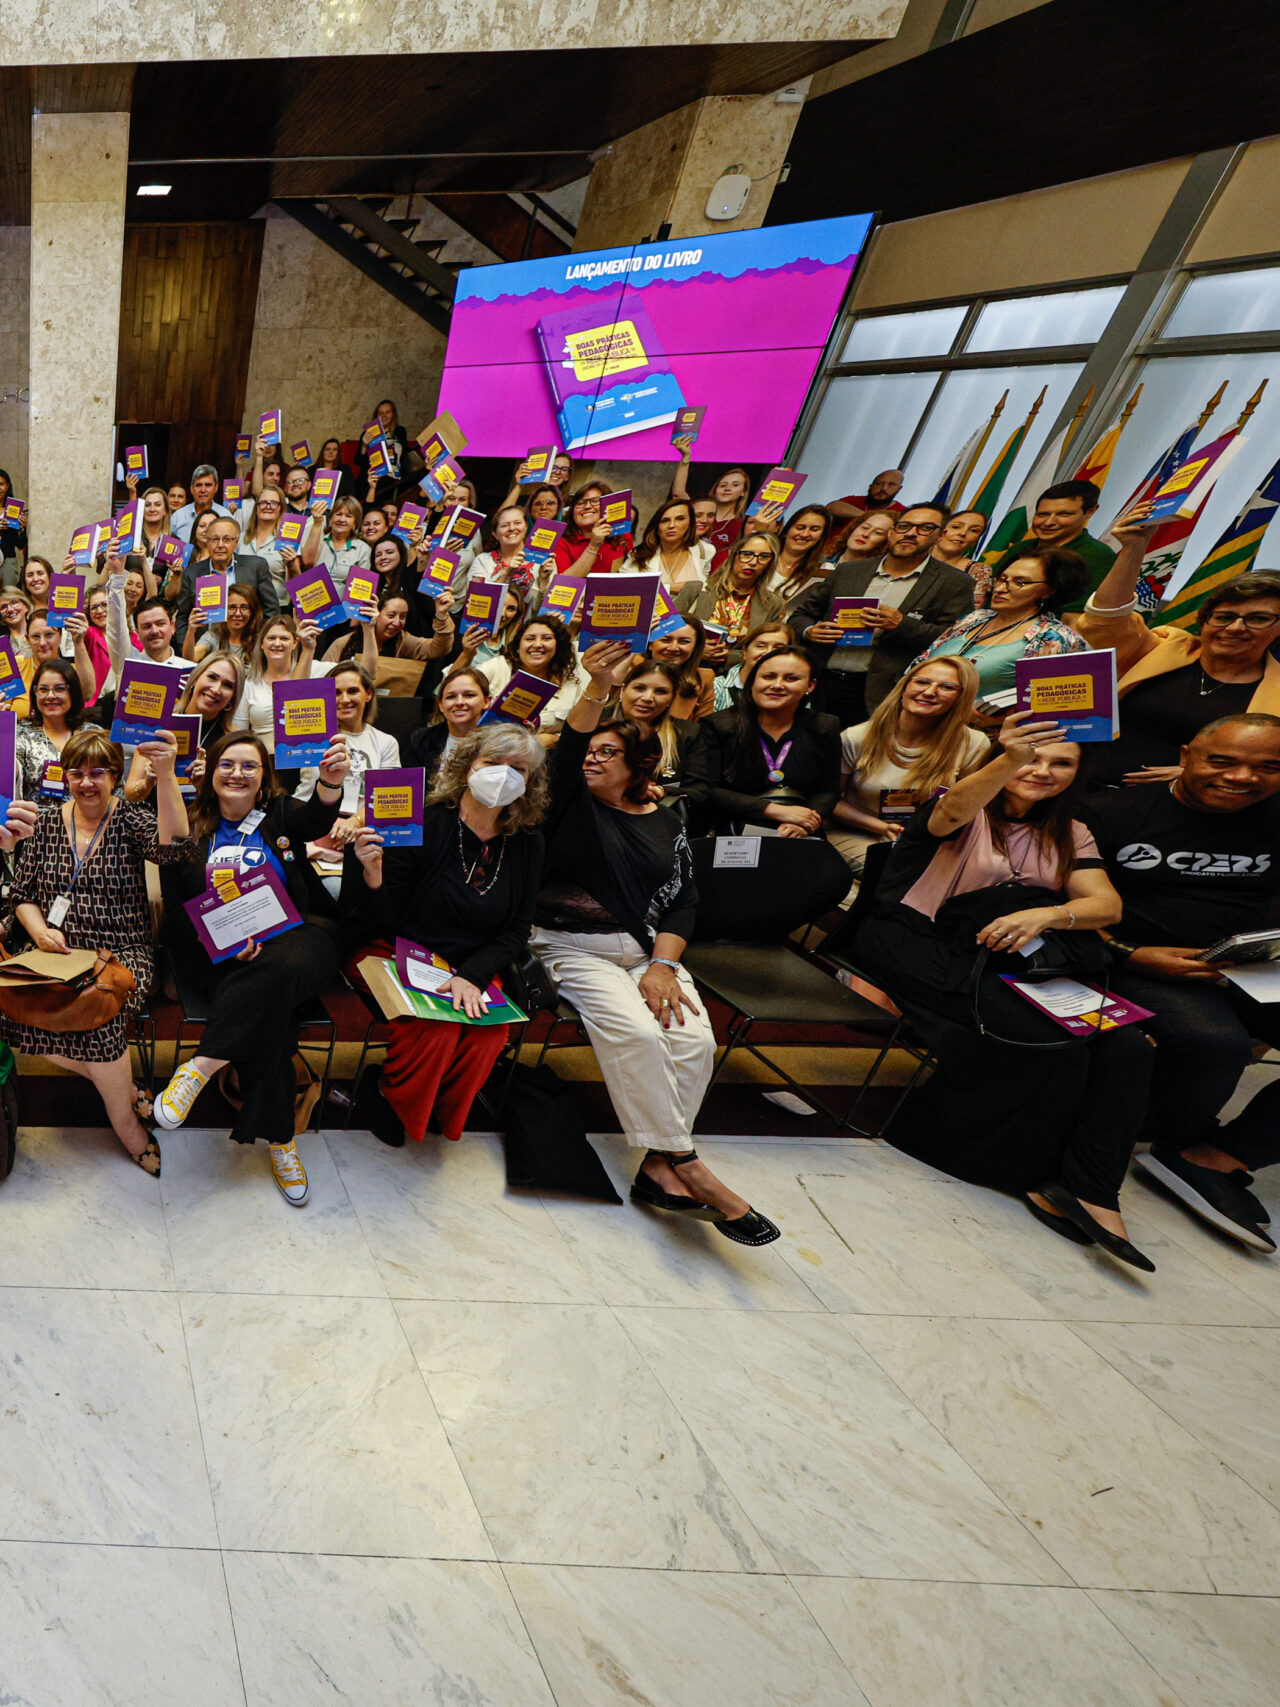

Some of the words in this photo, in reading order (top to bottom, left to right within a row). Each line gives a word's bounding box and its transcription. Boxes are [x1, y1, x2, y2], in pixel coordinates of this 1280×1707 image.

[565, 256, 642, 280] LANÇAMENTO
[644, 254, 663, 270] DO
[663, 249, 703, 268] LIVRO
[576, 340, 595, 350] BOAS
[596, 331, 630, 344] PRÁTICAS
[1055, 682, 1086, 690] PRÁTICAS
